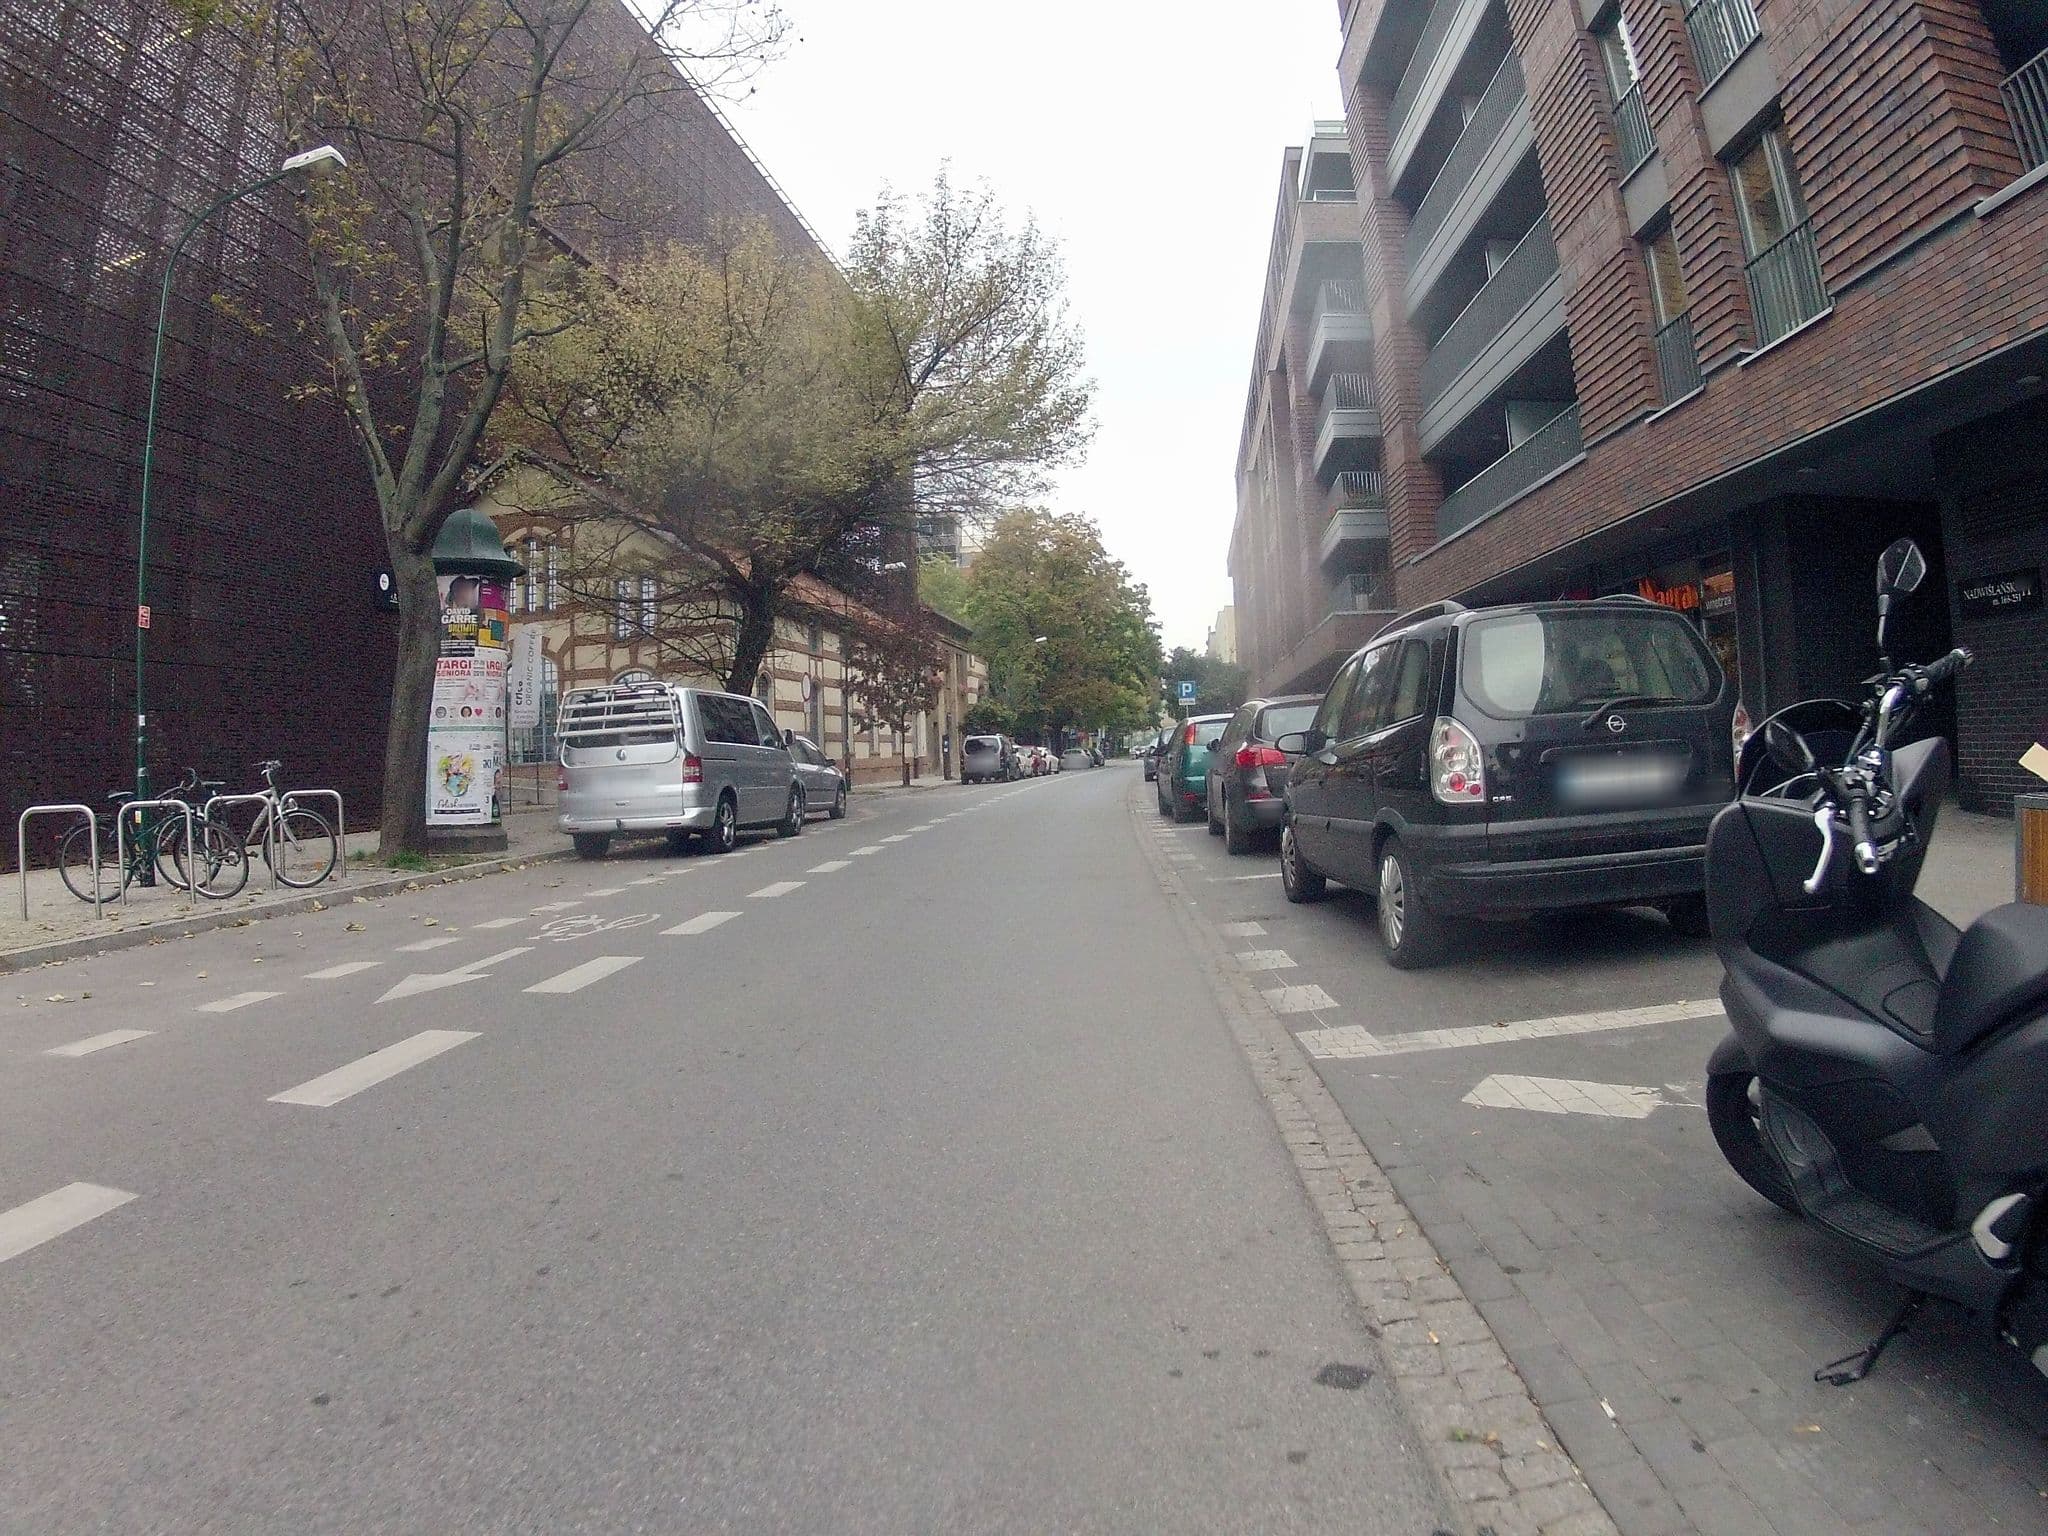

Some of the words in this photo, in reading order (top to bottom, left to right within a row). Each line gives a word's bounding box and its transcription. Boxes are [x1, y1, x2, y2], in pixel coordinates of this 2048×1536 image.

[436, 660, 471, 669] TARGI
[526, 666, 534, 706] ORGANIC
[1182, 683, 1192, 697] P
